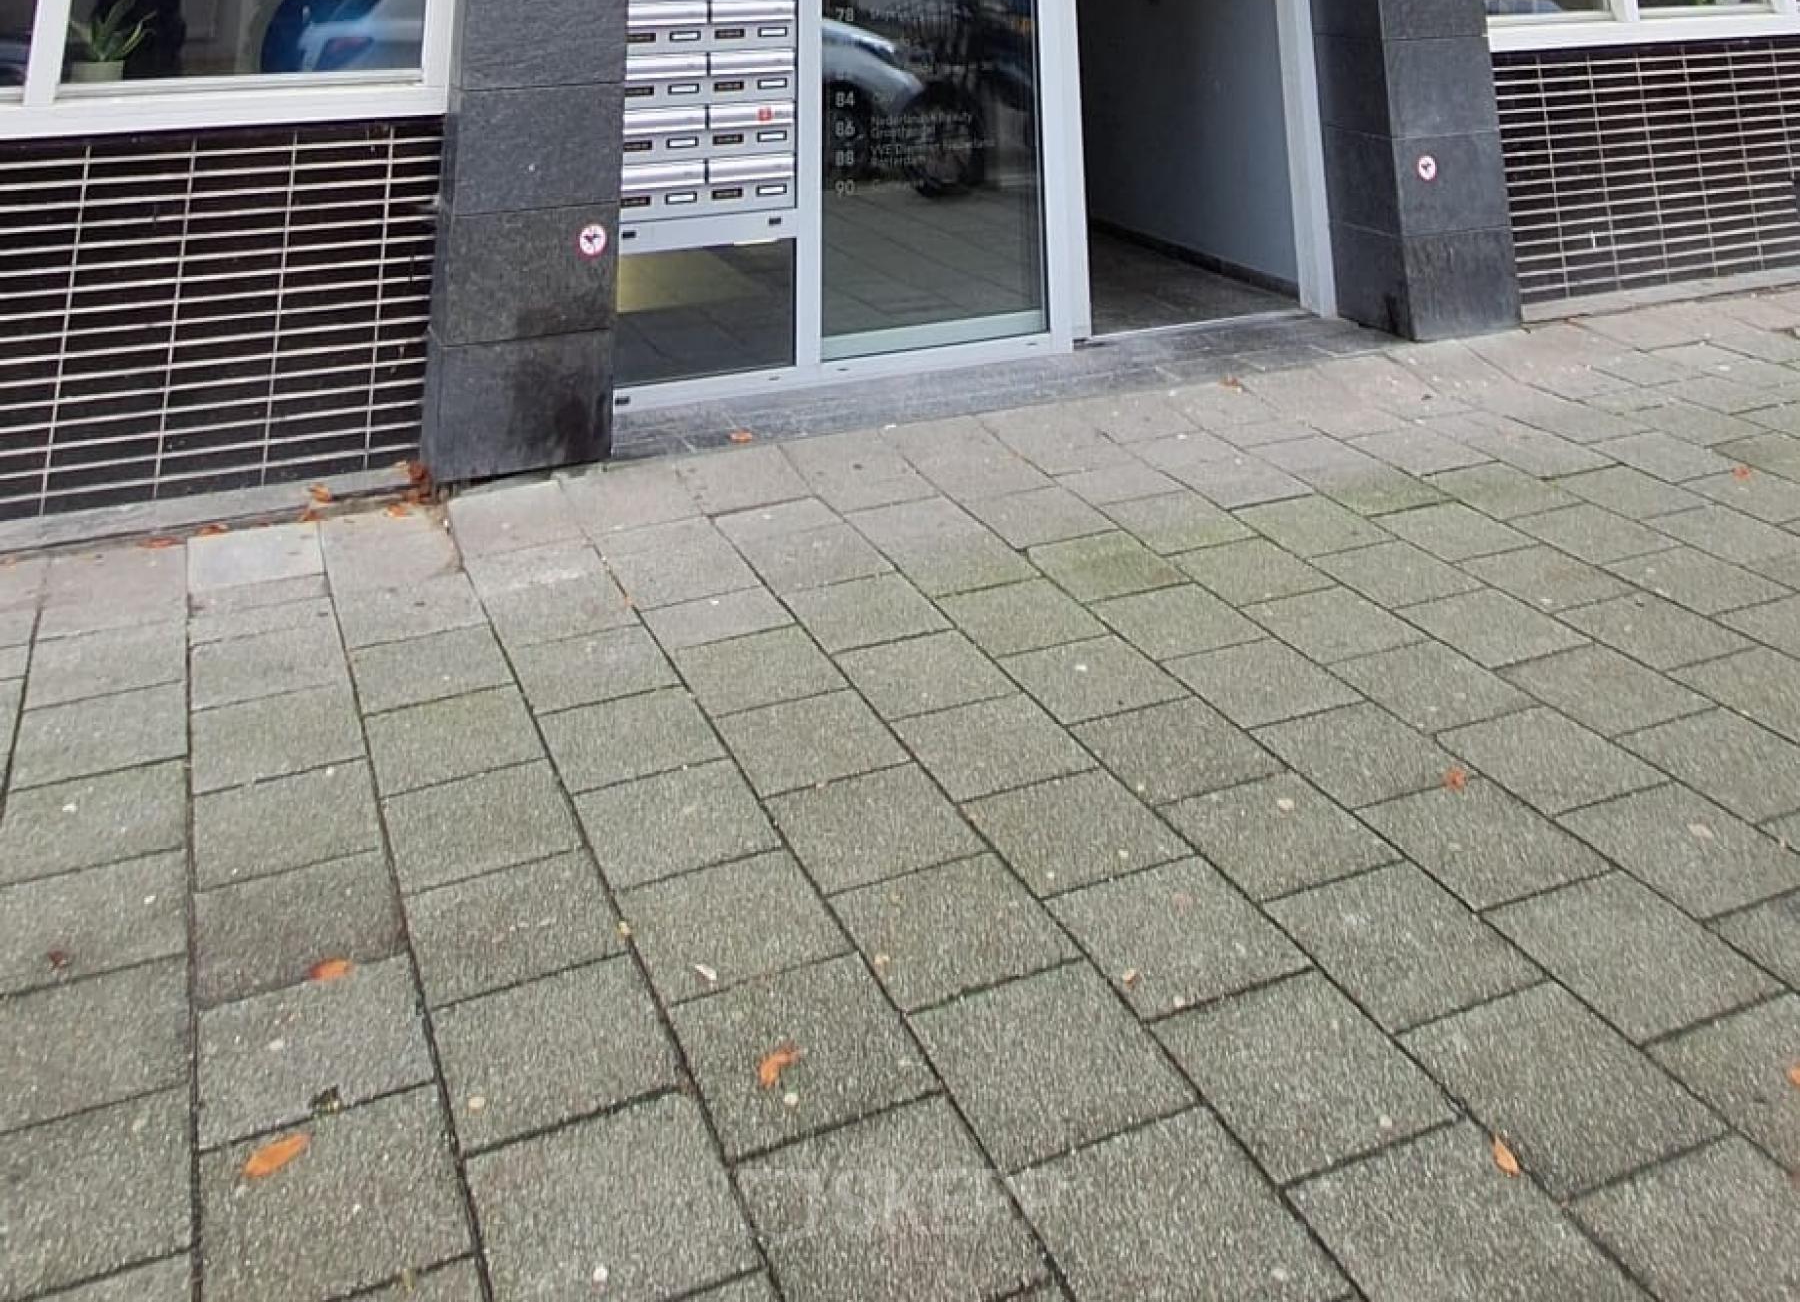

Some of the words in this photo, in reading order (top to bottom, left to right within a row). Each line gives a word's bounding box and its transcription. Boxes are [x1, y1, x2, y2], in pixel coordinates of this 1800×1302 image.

[835, 7, 854, 22] 78
[835, 92, 855, 107] 84
[835, 121, 855, 137] 86
[835, 181, 855, 197] 90
